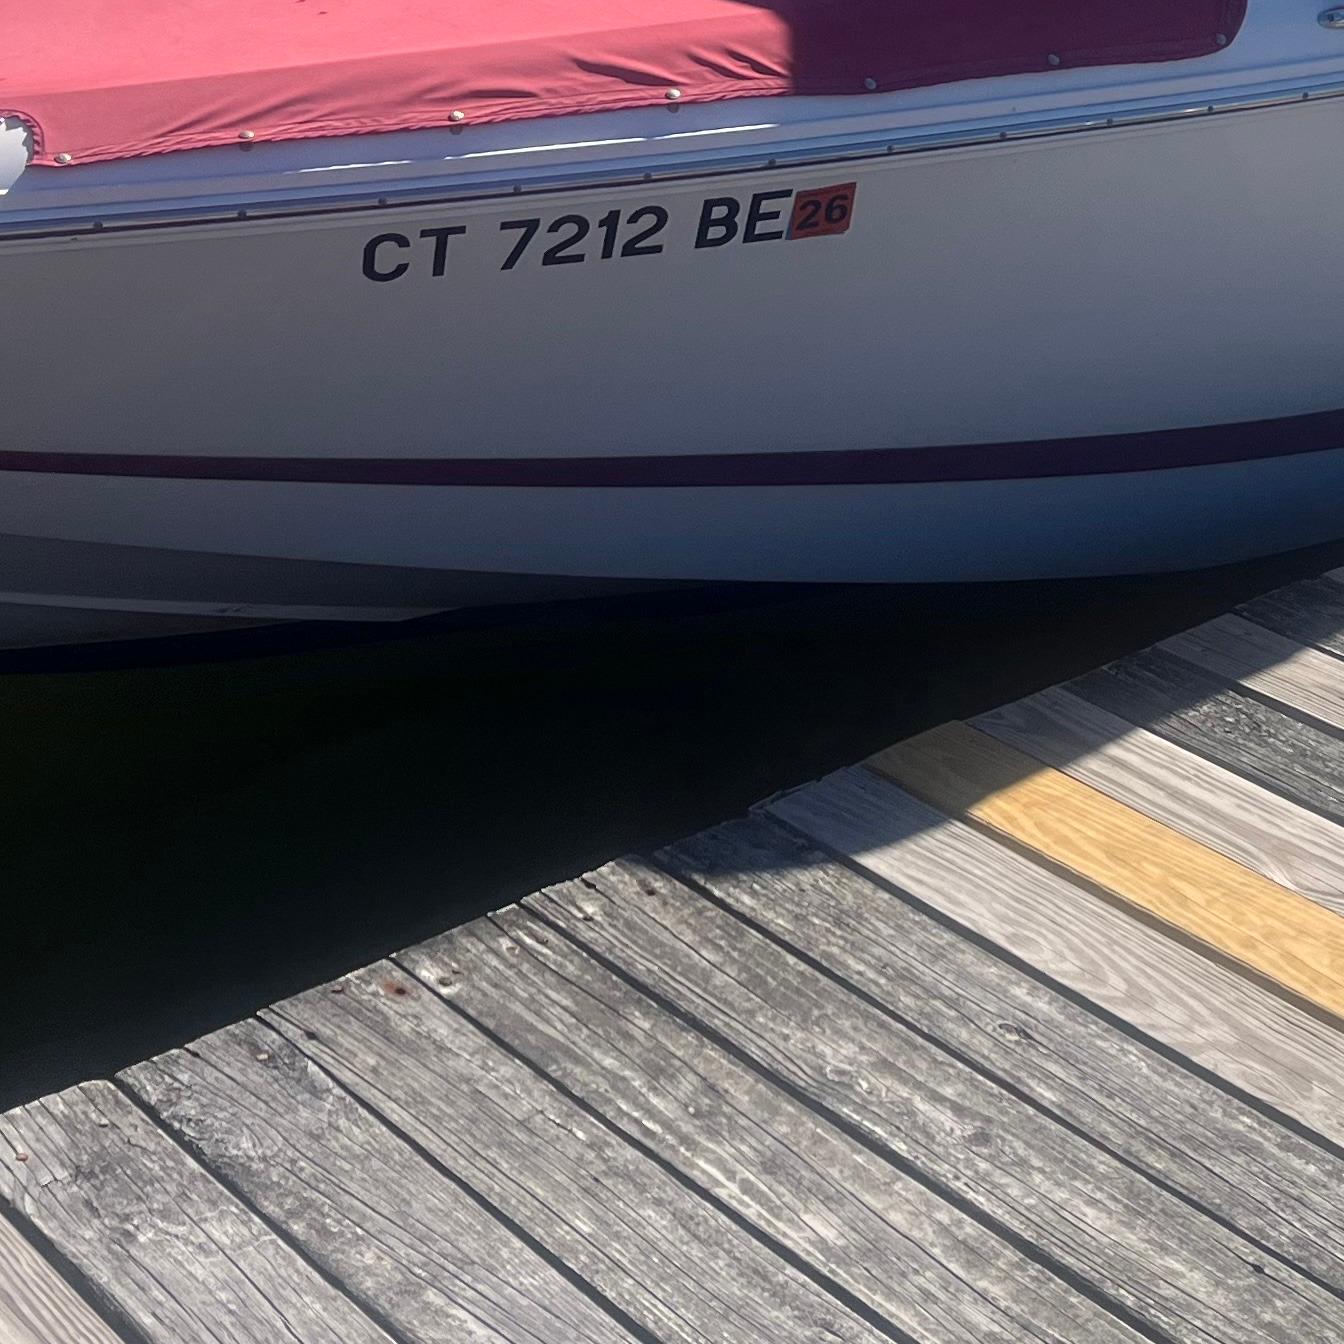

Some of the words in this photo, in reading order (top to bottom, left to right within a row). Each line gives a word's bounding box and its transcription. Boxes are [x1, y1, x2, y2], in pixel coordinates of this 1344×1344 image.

[362, 225, 467, 283] CT
[500, 205, 670, 272] 7212
[694, 188, 794, 250] BE
[796, 193, 849, 231] 26
